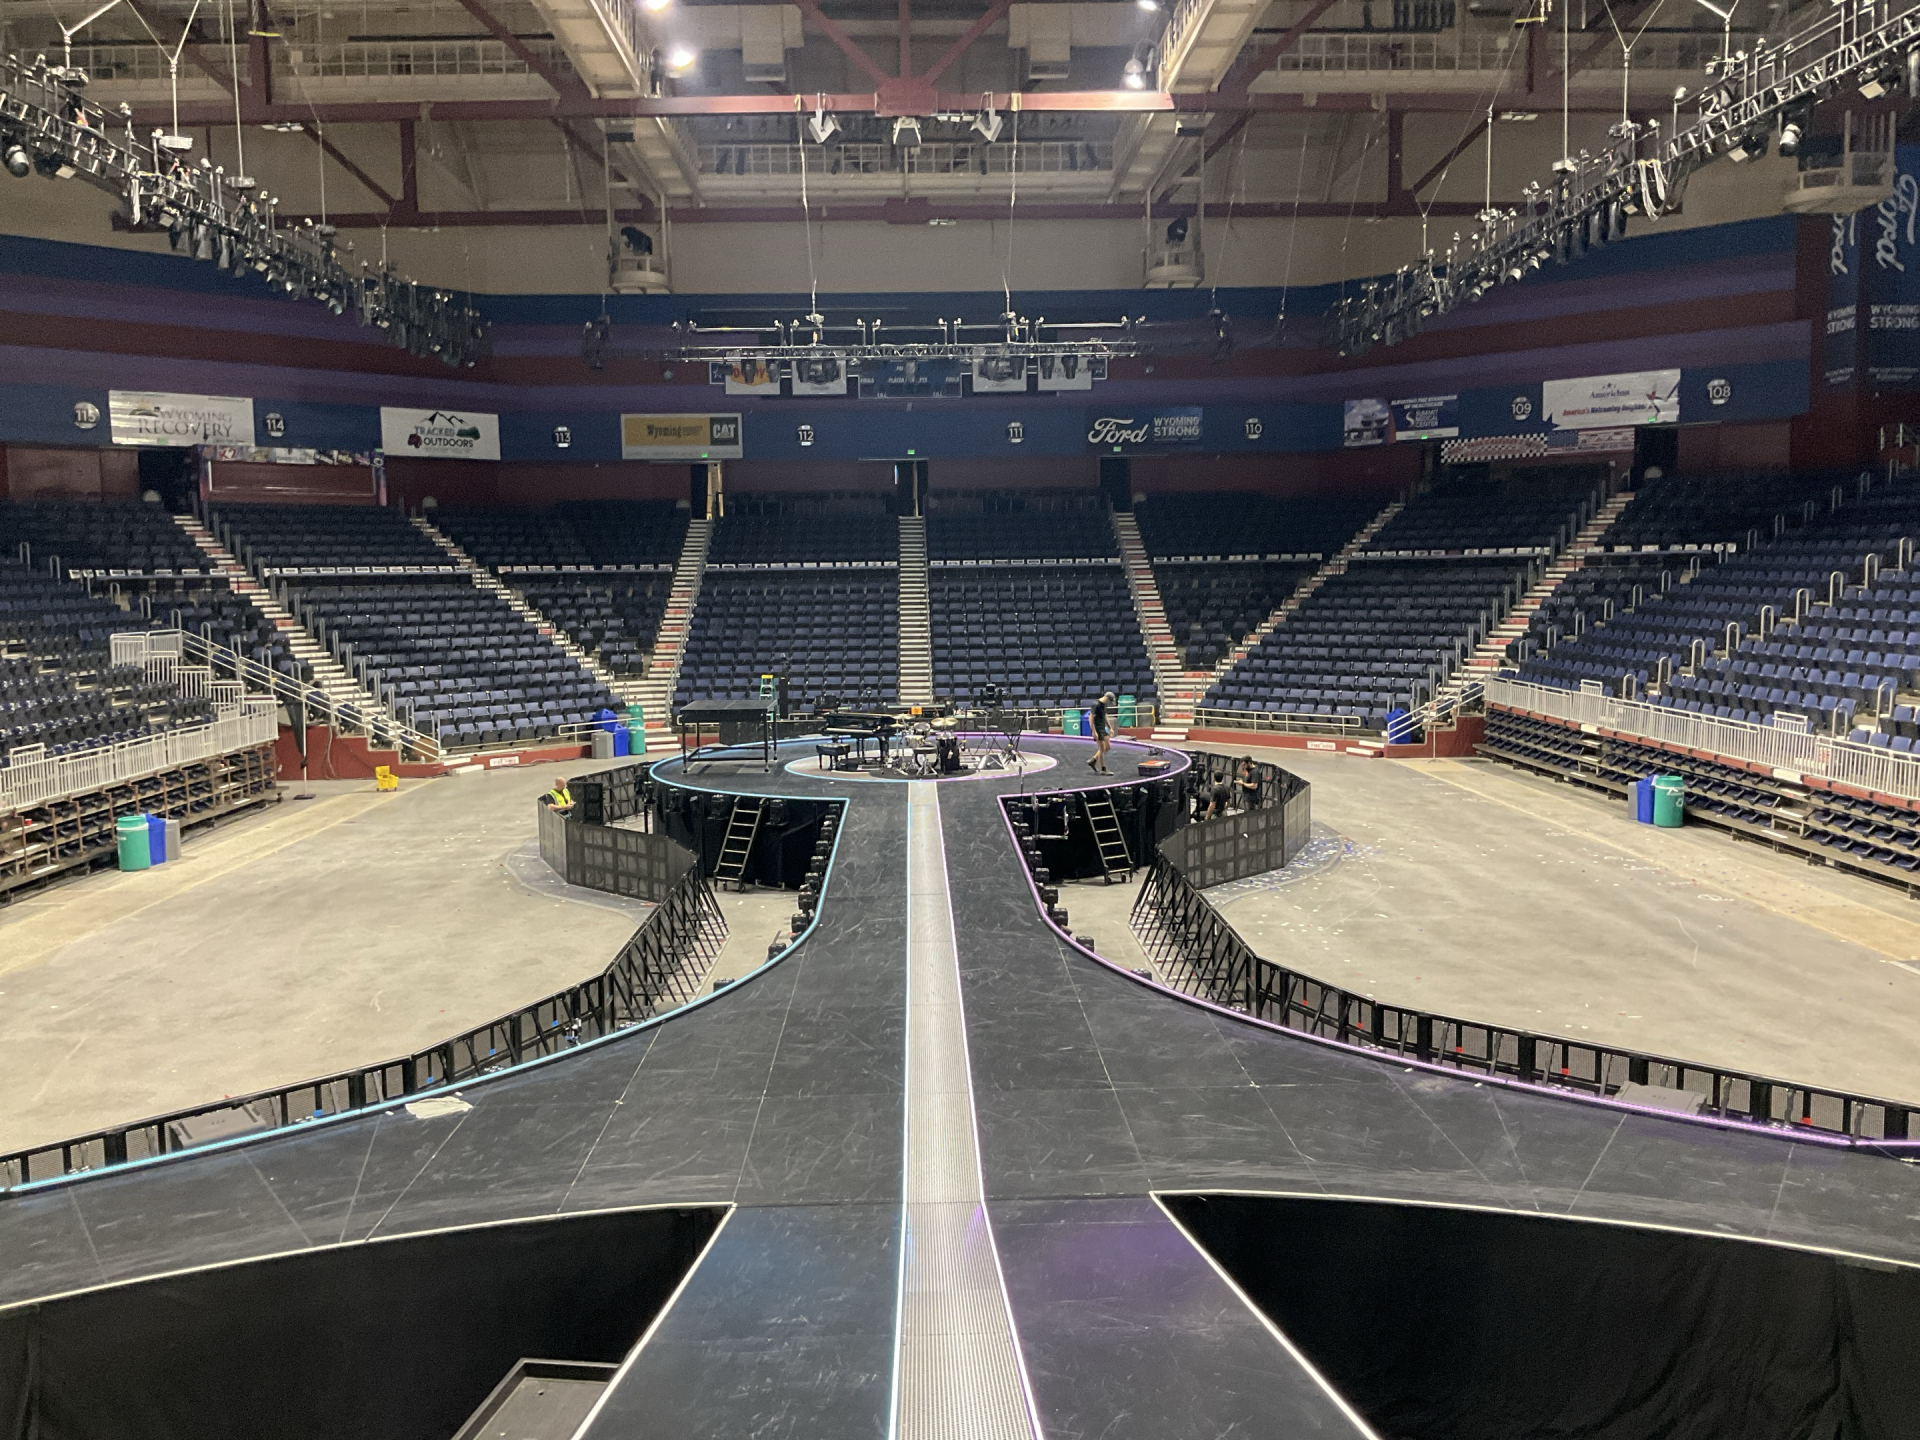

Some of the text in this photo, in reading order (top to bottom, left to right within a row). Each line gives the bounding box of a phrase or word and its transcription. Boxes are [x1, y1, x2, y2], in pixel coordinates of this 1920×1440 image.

[1869, 316, 1920, 329] STRONG
[1707, 385, 1731, 399] 108
[160, 408, 233, 422] WYOMING
[1511, 402, 1532, 415] 109
[75, 408, 97, 423] 115
[1153, 416, 1200, 426] WYOMING
[138, 418, 233, 437] RECOVERY
[266, 418, 285, 432] 114
[414, 425, 455, 437] TRACKED
[646, 423, 682, 438] Wyoming
[712, 423, 736, 439] CAT
[1088, 418, 1149, 443] Ford
[1153, 426, 1200, 436] STRONG
[1244, 423, 1263, 434] 110
[554, 432, 571, 443] 113
[798, 430, 814, 441] 112
[1009, 427, 1023, 438] 111
[423, 436, 474, 448] OUTDOORS
